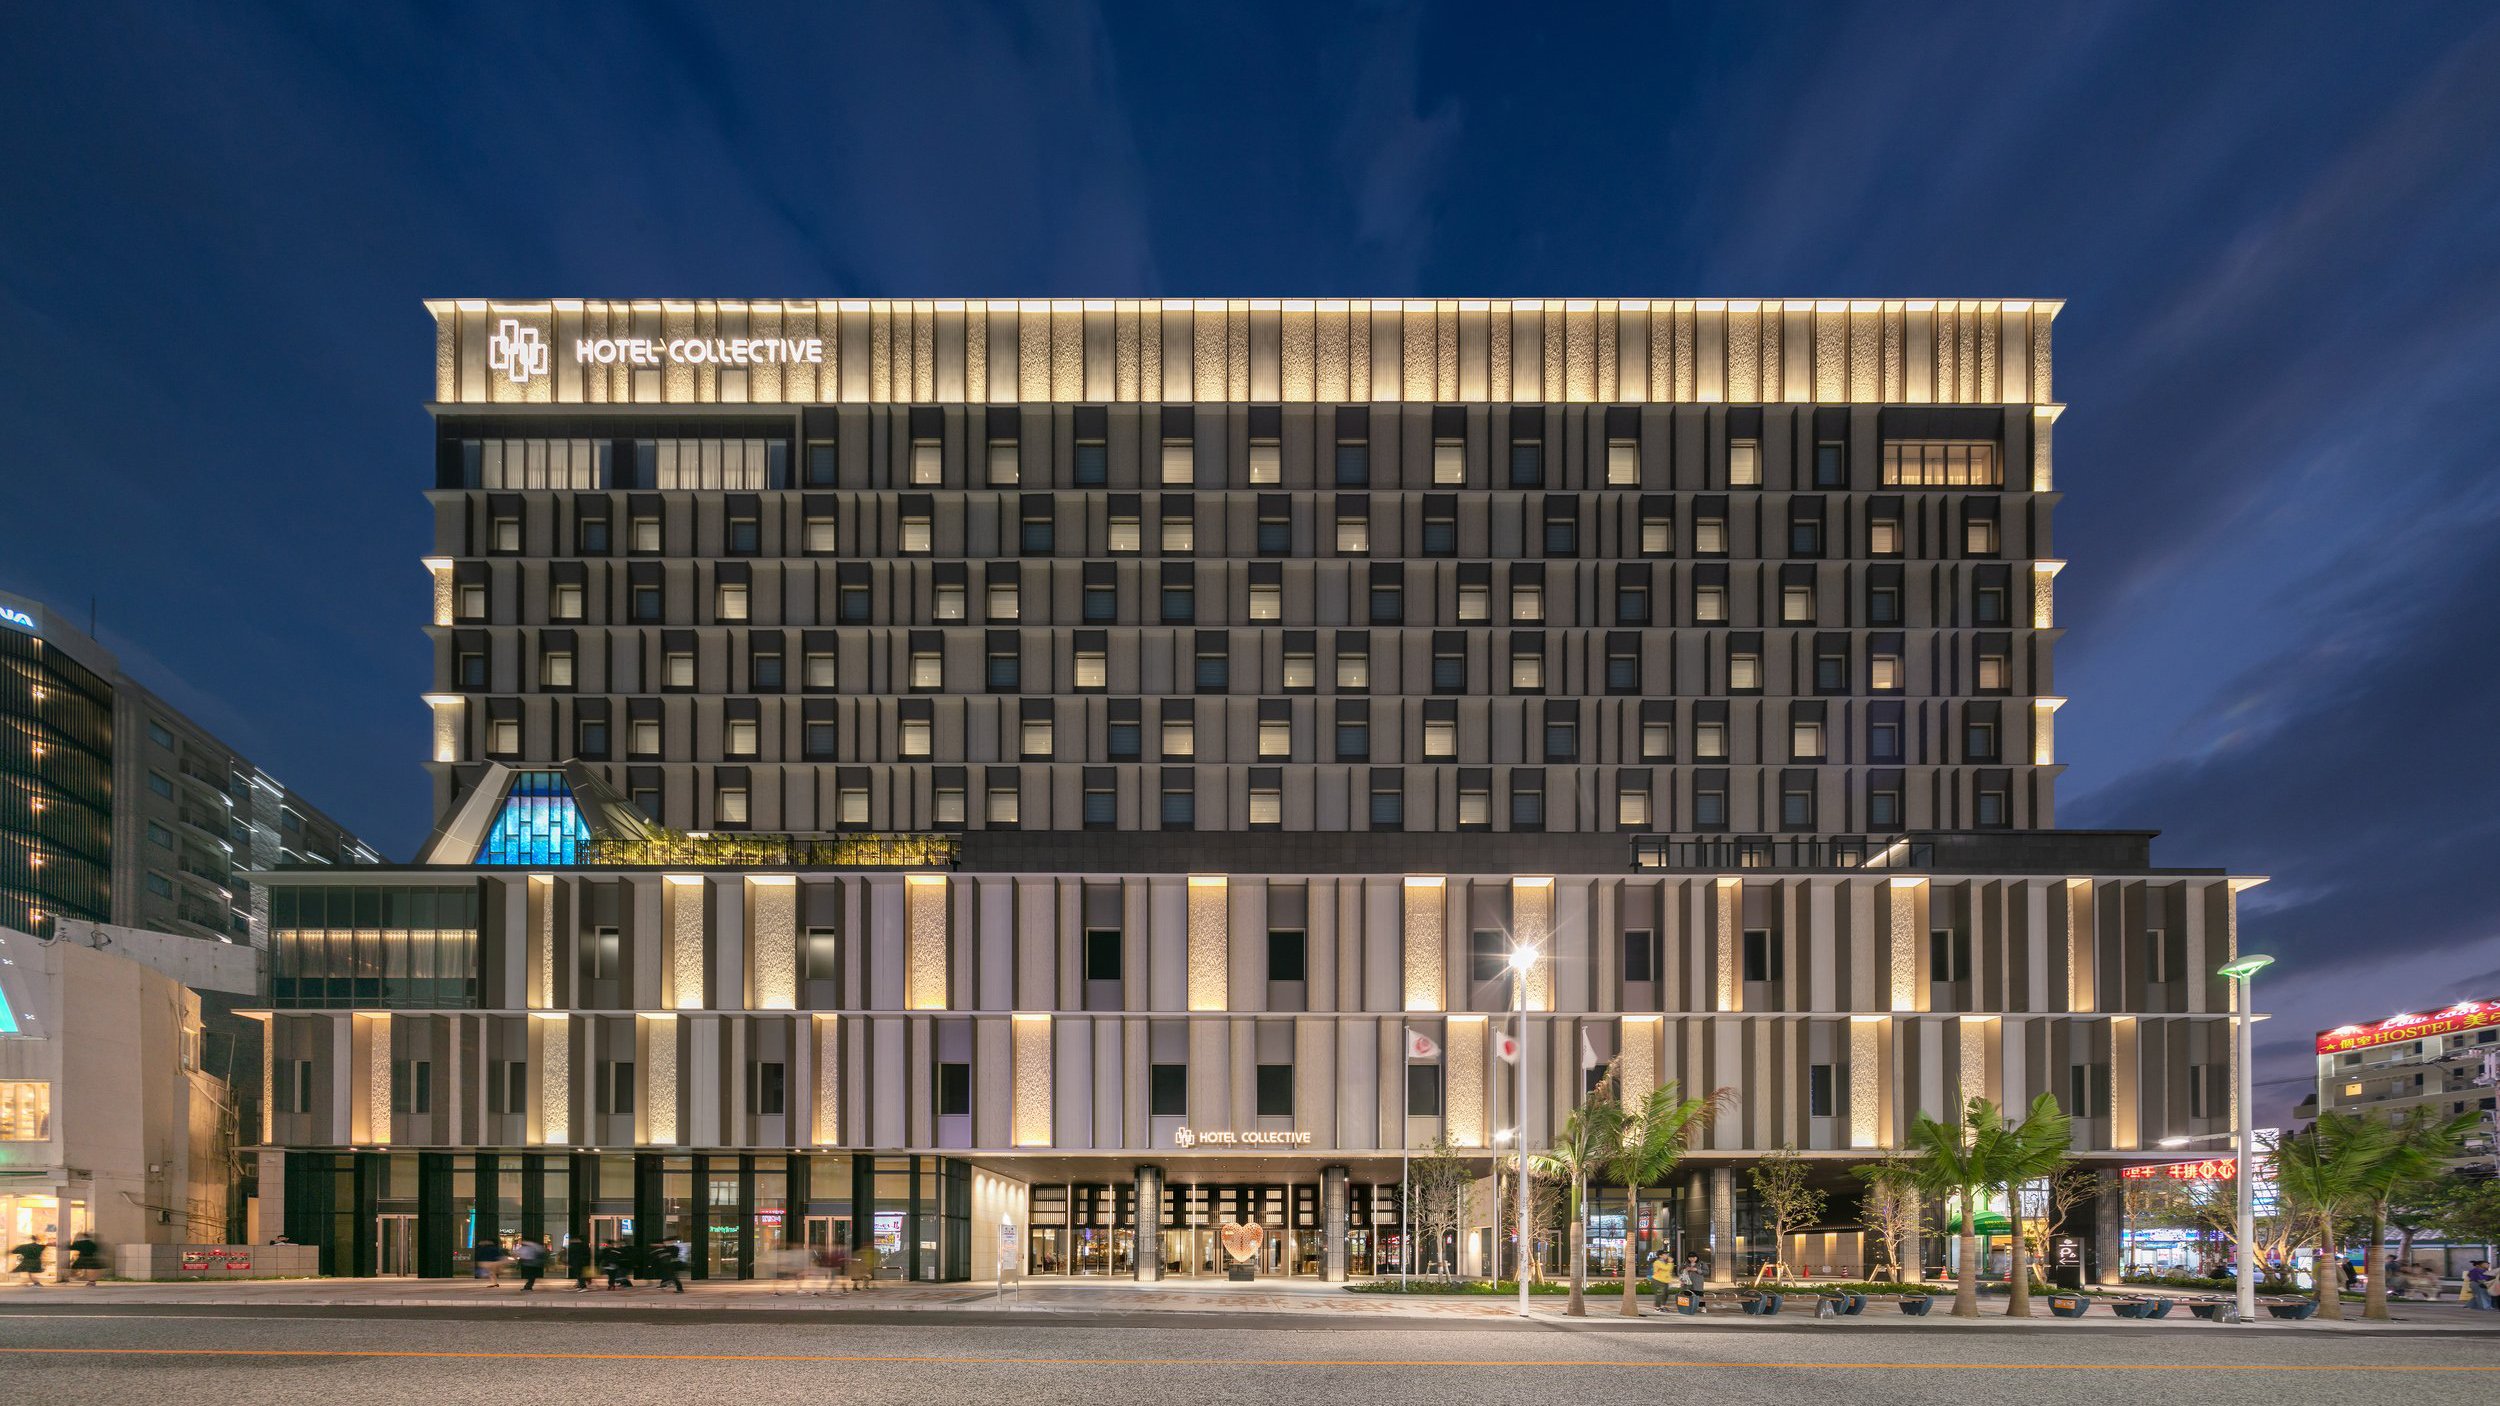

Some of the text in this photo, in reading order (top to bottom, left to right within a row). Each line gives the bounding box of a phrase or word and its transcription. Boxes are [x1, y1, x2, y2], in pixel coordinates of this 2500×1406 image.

[577, 338, 822, 363] HOTEL COLLECTIVE
[2374, 1019, 2459, 1043] HOSTEL
[1199, 1131, 1311, 1143] HOTEL COLLECTIVE
